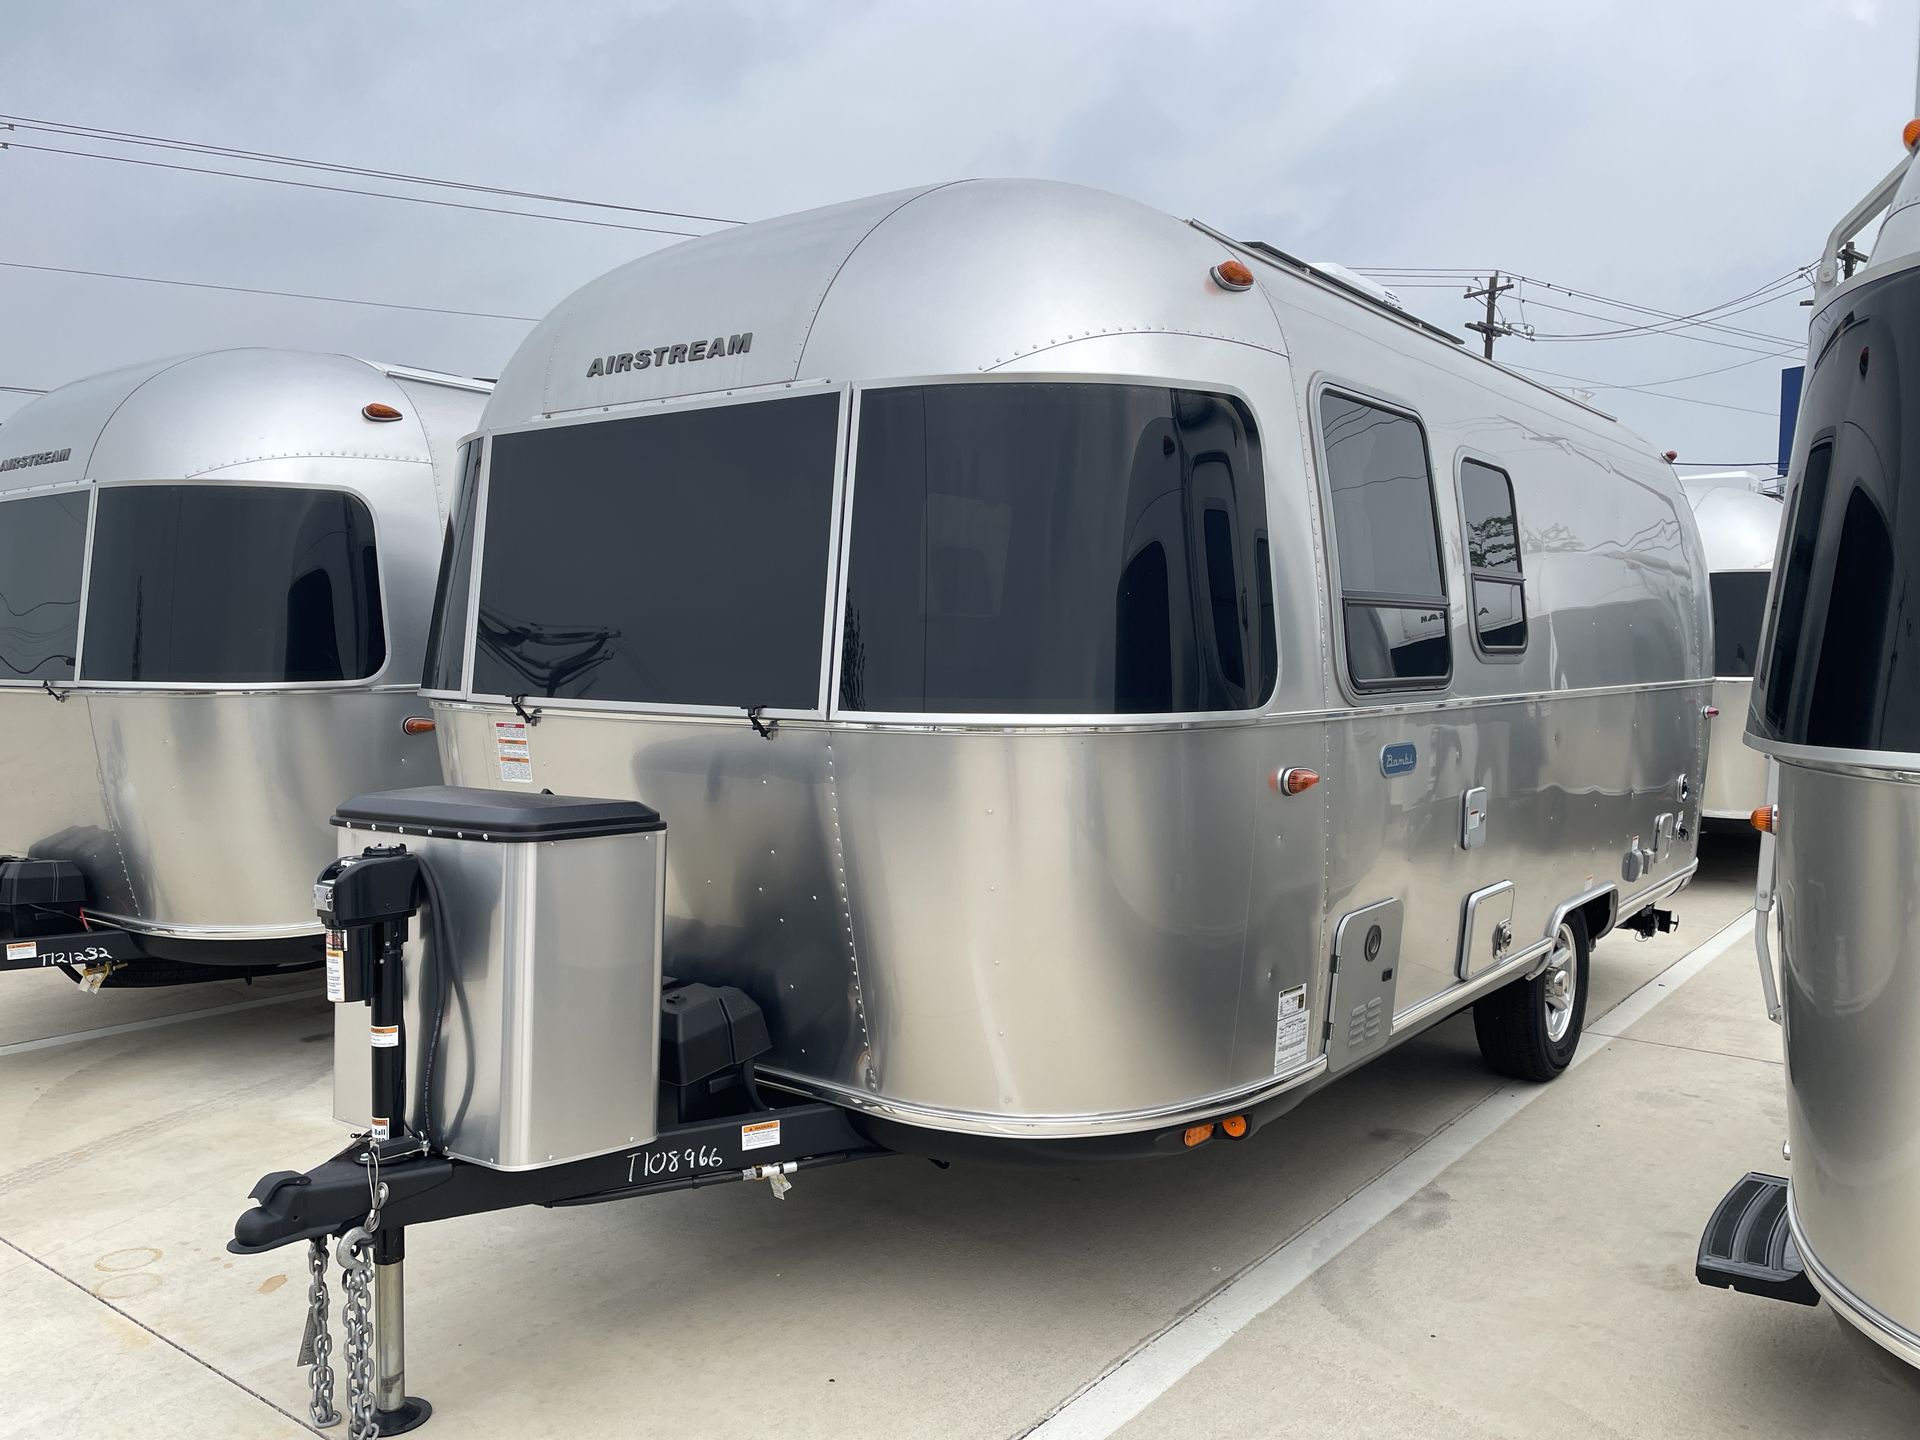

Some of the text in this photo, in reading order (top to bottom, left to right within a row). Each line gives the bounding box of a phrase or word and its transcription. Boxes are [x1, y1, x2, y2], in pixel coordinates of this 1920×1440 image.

[587, 332, 753, 377] AIRSTREAM
[0, 448, 71, 472] AIRSTREAM
[627, 1145, 723, 1182] T108966
